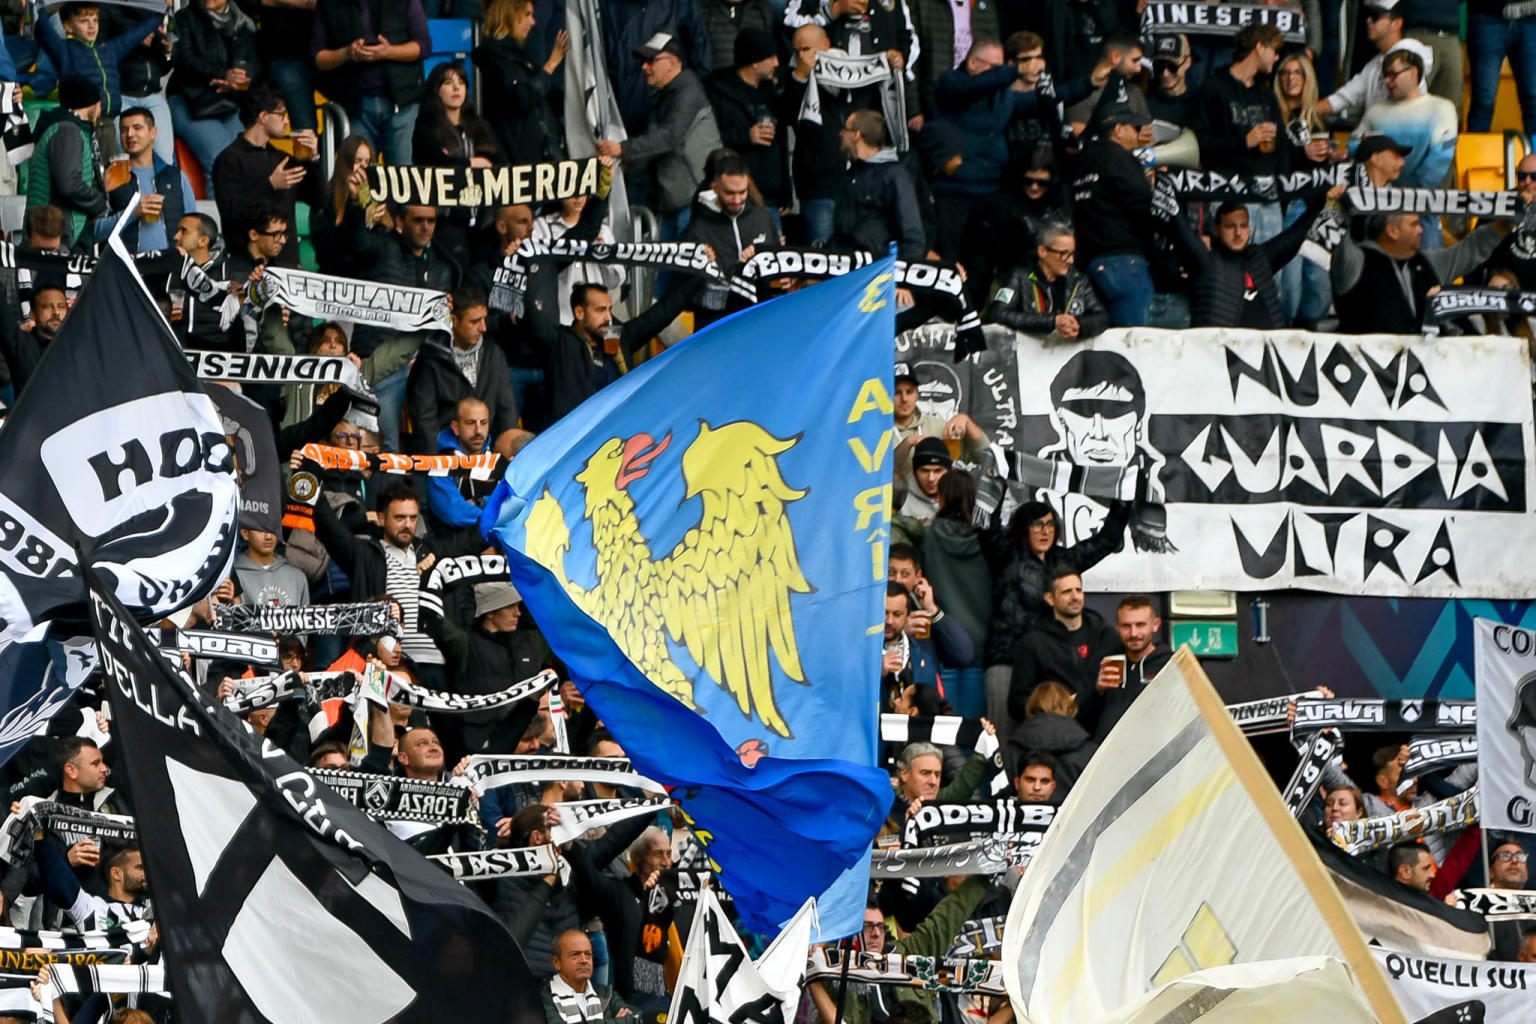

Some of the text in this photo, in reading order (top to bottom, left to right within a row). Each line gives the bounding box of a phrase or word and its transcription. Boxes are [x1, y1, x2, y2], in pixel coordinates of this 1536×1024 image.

[370, 158, 599, 206] JUVE MERDA
[1348, 187, 1518, 216] UDINESE
[288, 274, 425, 315] FRIULANI
[1224, 337, 1449, 410] NUOVA
[1181, 422, 1509, 502] GUARDIA
[261, 607, 336, 631] UDINESE
[1386, 954, 1527, 990] QUELLI SUI
